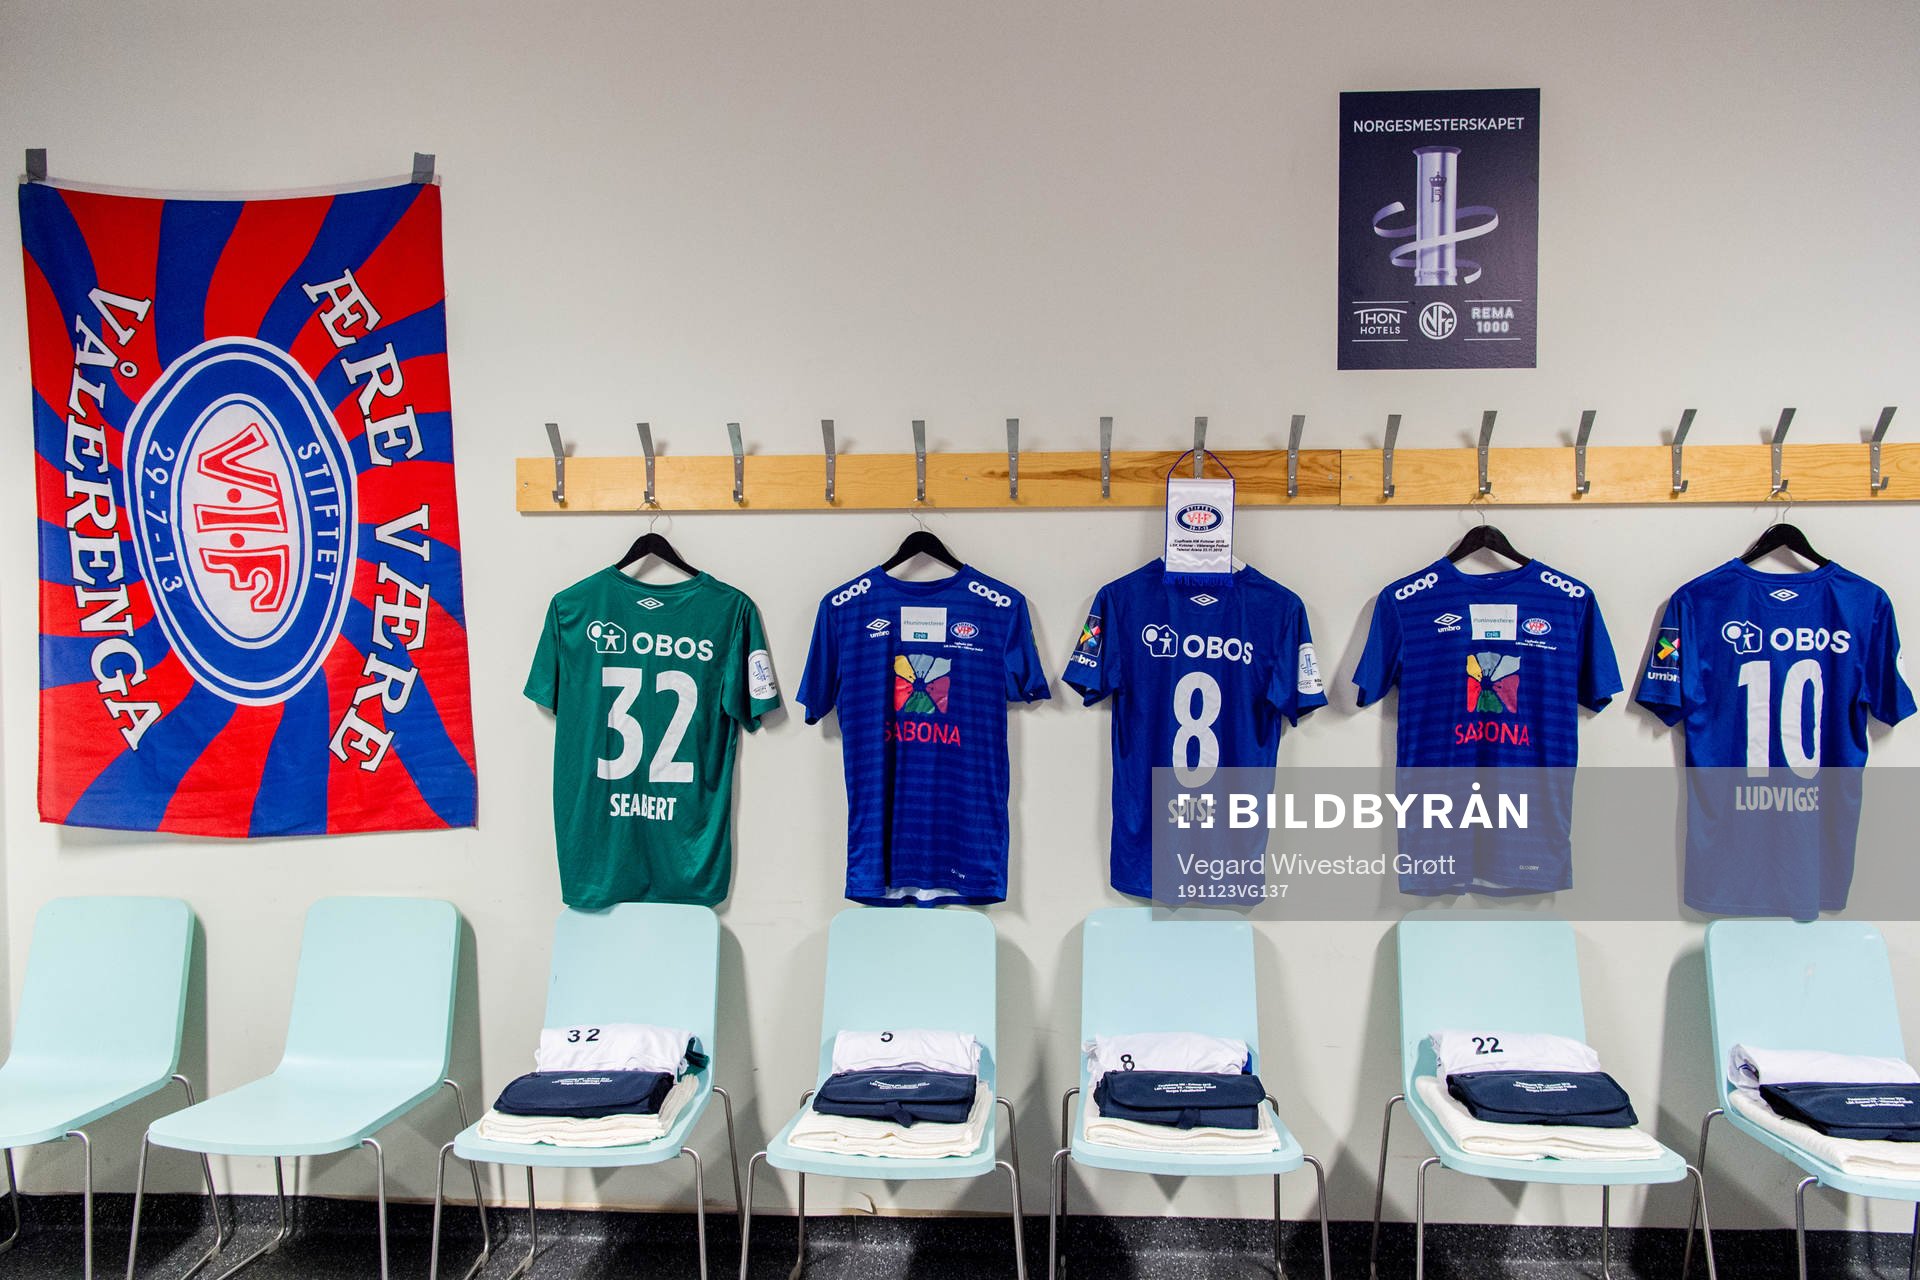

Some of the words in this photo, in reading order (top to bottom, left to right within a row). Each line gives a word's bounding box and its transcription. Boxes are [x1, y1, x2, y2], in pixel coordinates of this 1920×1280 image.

[1353, 117, 1525, 133] NORGESMESTERSKAPET
[1355, 309, 1405, 324] THON
[1471, 307, 1514, 319] REMA
[1360, 327, 1401, 335] HOTELS
[1476, 321, 1510, 333] 1000
[302, 268, 424, 467] ÆRE
[64, 287, 163, 752] VÅLERENGA
[145, 440, 184, 593] 29-7-13
[298, 441, 339, 585] STIFTET
[329, 504, 430, 772] VÆRE
[870, 630, 890, 639] umbro
[1438, 625, 1461, 633] umbro
[1770, 627, 1851, 654] OBOS
[632, 631, 714, 661] OBOS
[1182, 634, 1254, 665] OBOS
[596, 666, 698, 783] 32
[1172, 671, 1222, 789] 8
[1737, 659, 1824, 779] 10
[884, 721, 961, 747] SABONA
[1455, 720, 1530, 746] SABONA
[567, 1027, 601, 1044] 32
[1471, 1036, 1504, 1054] 22
[1120, 1054, 1135, 1072] 8
